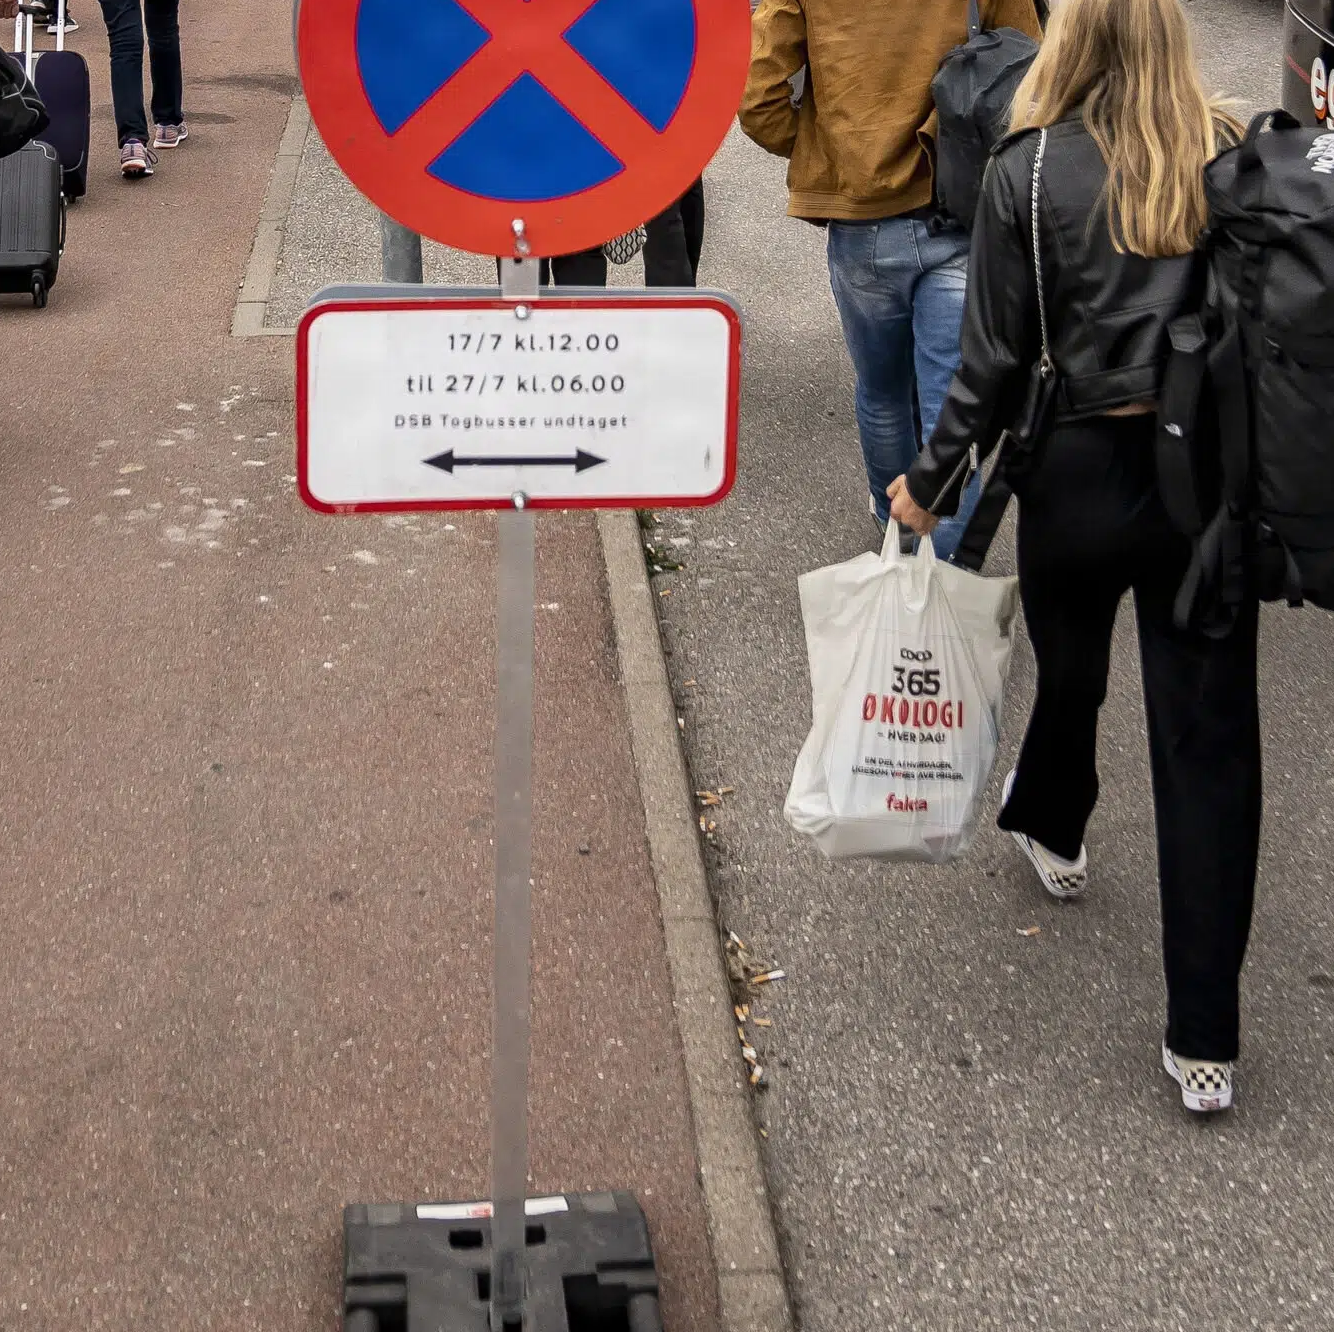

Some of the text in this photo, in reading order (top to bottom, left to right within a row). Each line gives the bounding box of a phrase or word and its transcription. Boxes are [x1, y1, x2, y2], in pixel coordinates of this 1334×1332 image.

[448, 333, 620, 353] 17/7 kl.12.00
[407, 374, 626, 395] til 27/7 kl.06.00
[394, 414, 627, 429] DSB Togbusser undtaget
[891, 665, 941, 696] 365
[862, 692, 964, 729] ØKOLOGI
